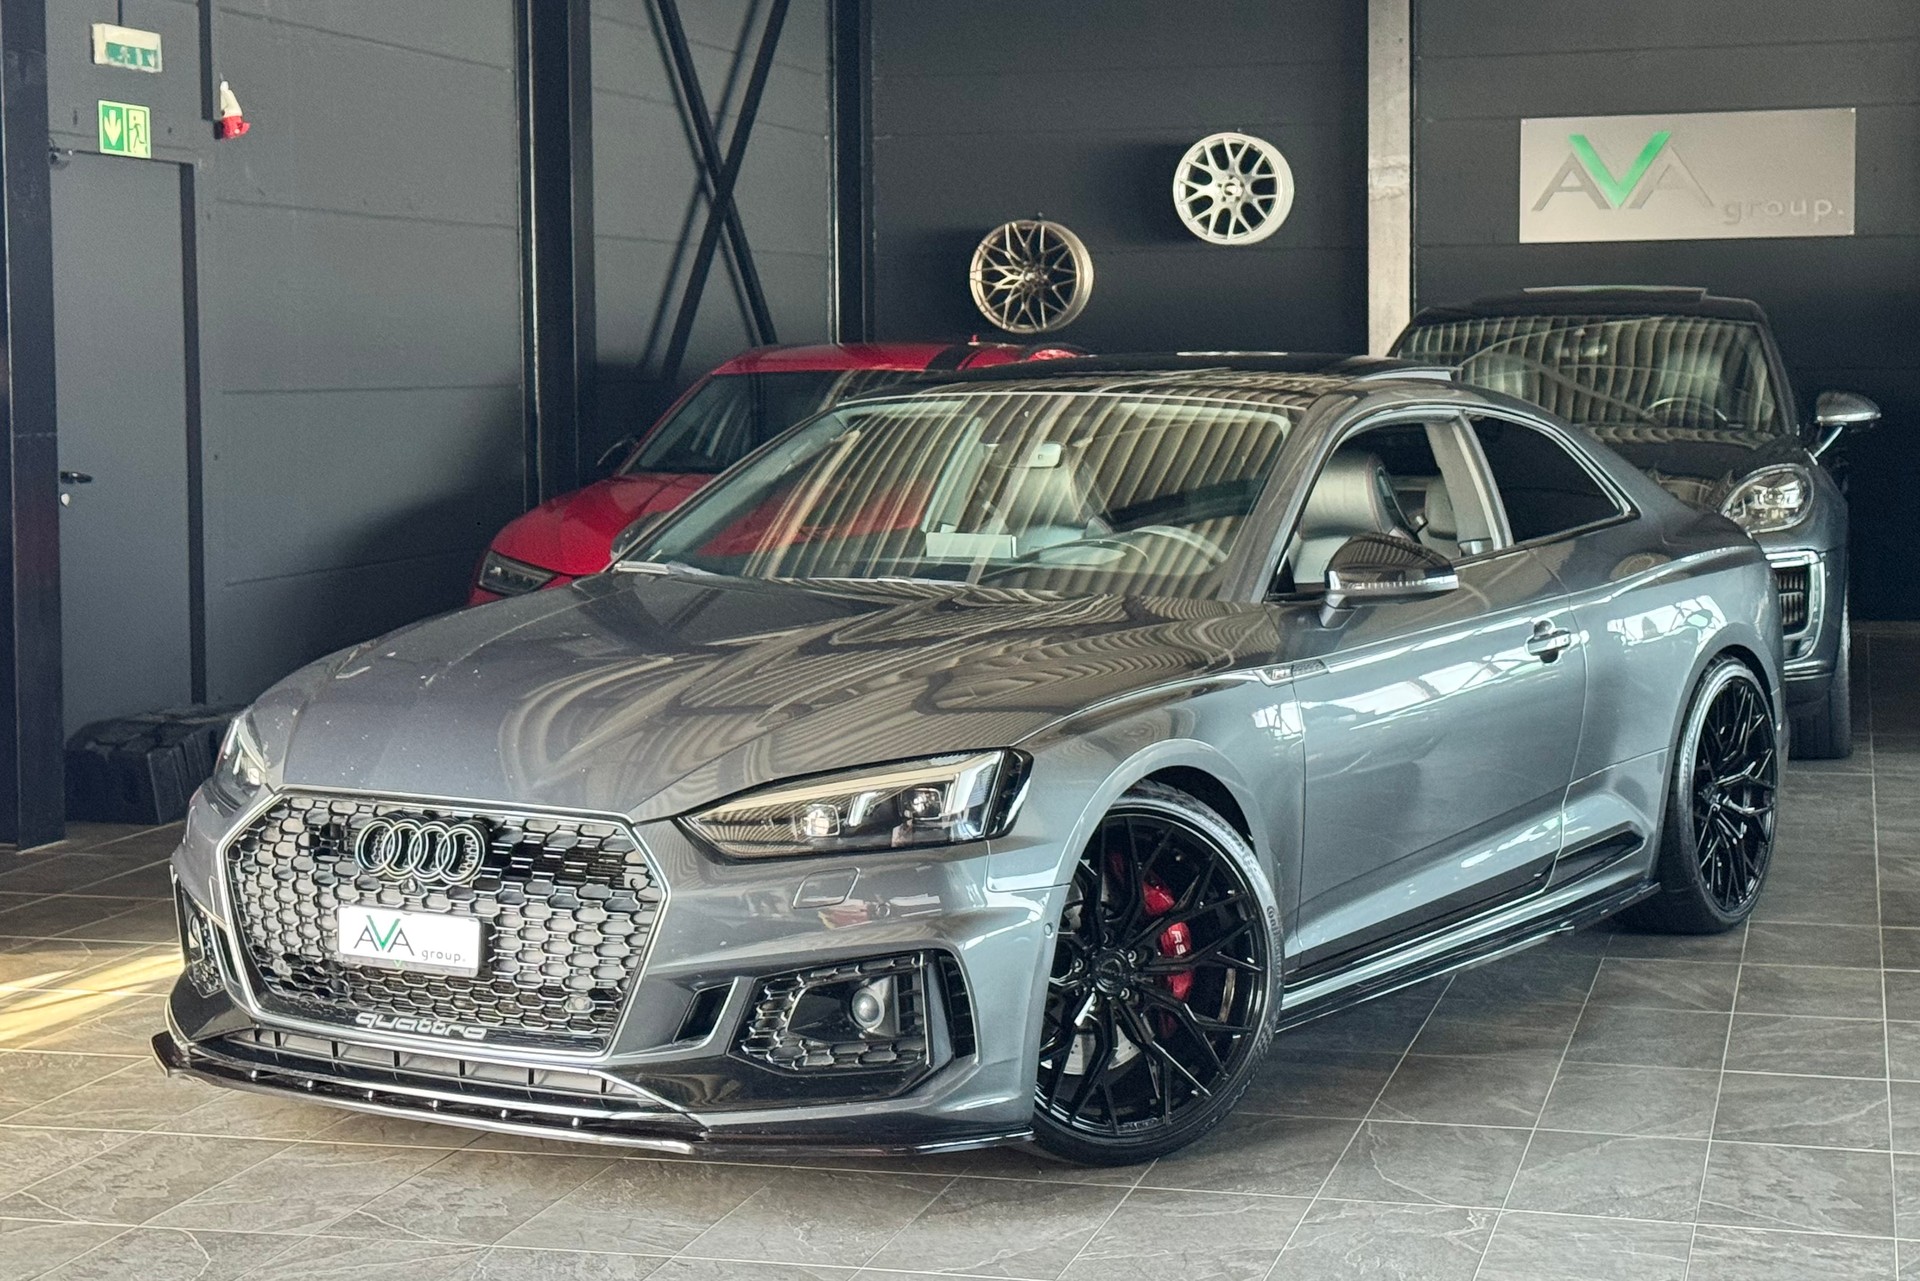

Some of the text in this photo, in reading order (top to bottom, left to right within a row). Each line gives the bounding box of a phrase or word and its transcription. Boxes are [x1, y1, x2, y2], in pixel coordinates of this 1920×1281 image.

[1531, 130, 1845, 226] AVA group.
[354, 915, 466, 963] AVA group.
[1171, 930, 1187, 955] RS
[355, 1011, 487, 1040] quattro
